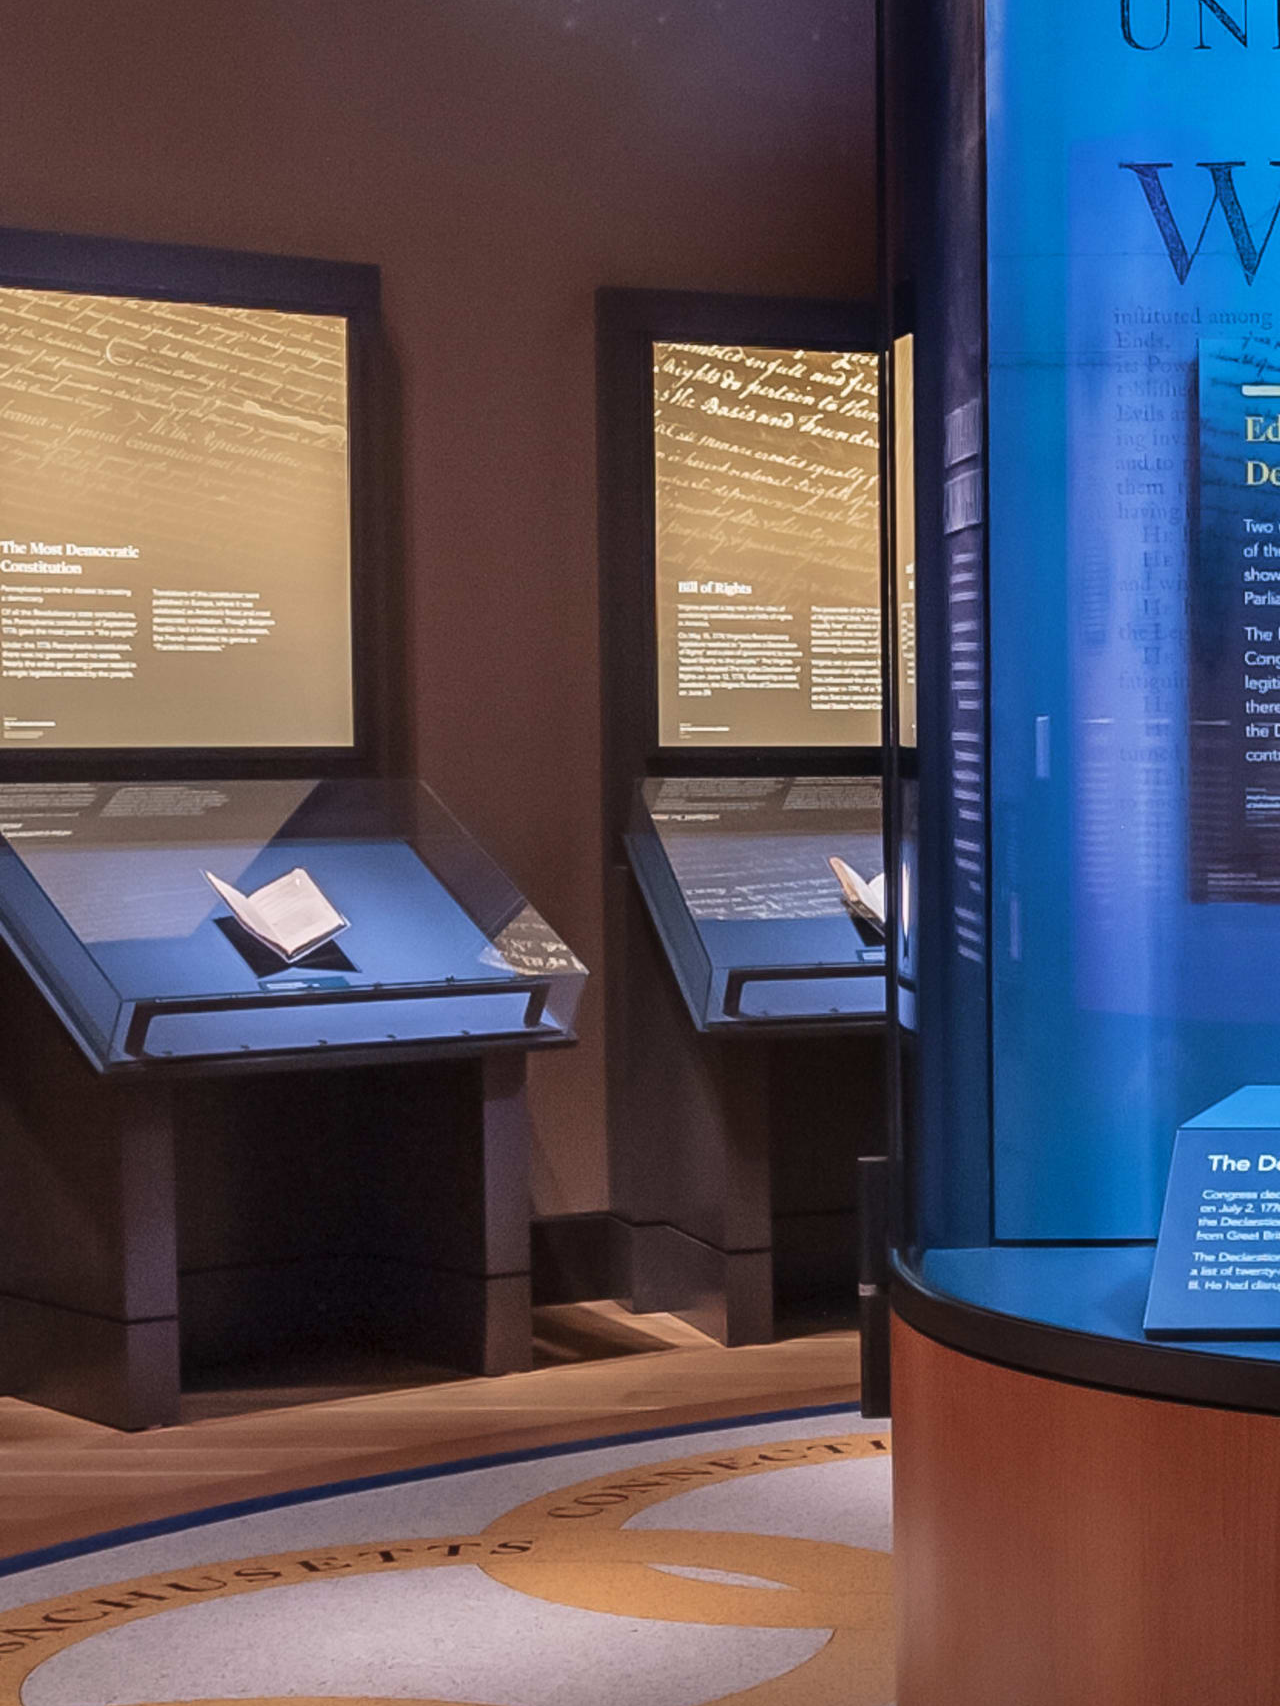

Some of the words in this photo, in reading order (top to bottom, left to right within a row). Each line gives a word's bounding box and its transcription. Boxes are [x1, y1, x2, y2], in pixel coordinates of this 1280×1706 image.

[1244, 519, 1273, 533] Two
[1, 541, 26, 554] The
[30, 542, 63, 556] Most
[66, 543, 140, 559] Democratic
[1244, 543, 1258, 558] of
[0, 560, 82, 575] Constitution
[700, 581, 714, 593] of
[715, 581, 752, 597] Rights
[1244, 627, 1272, 642] The
[1246, 724, 1269, 738] the
[1208, 1154, 1250, 1172] The
